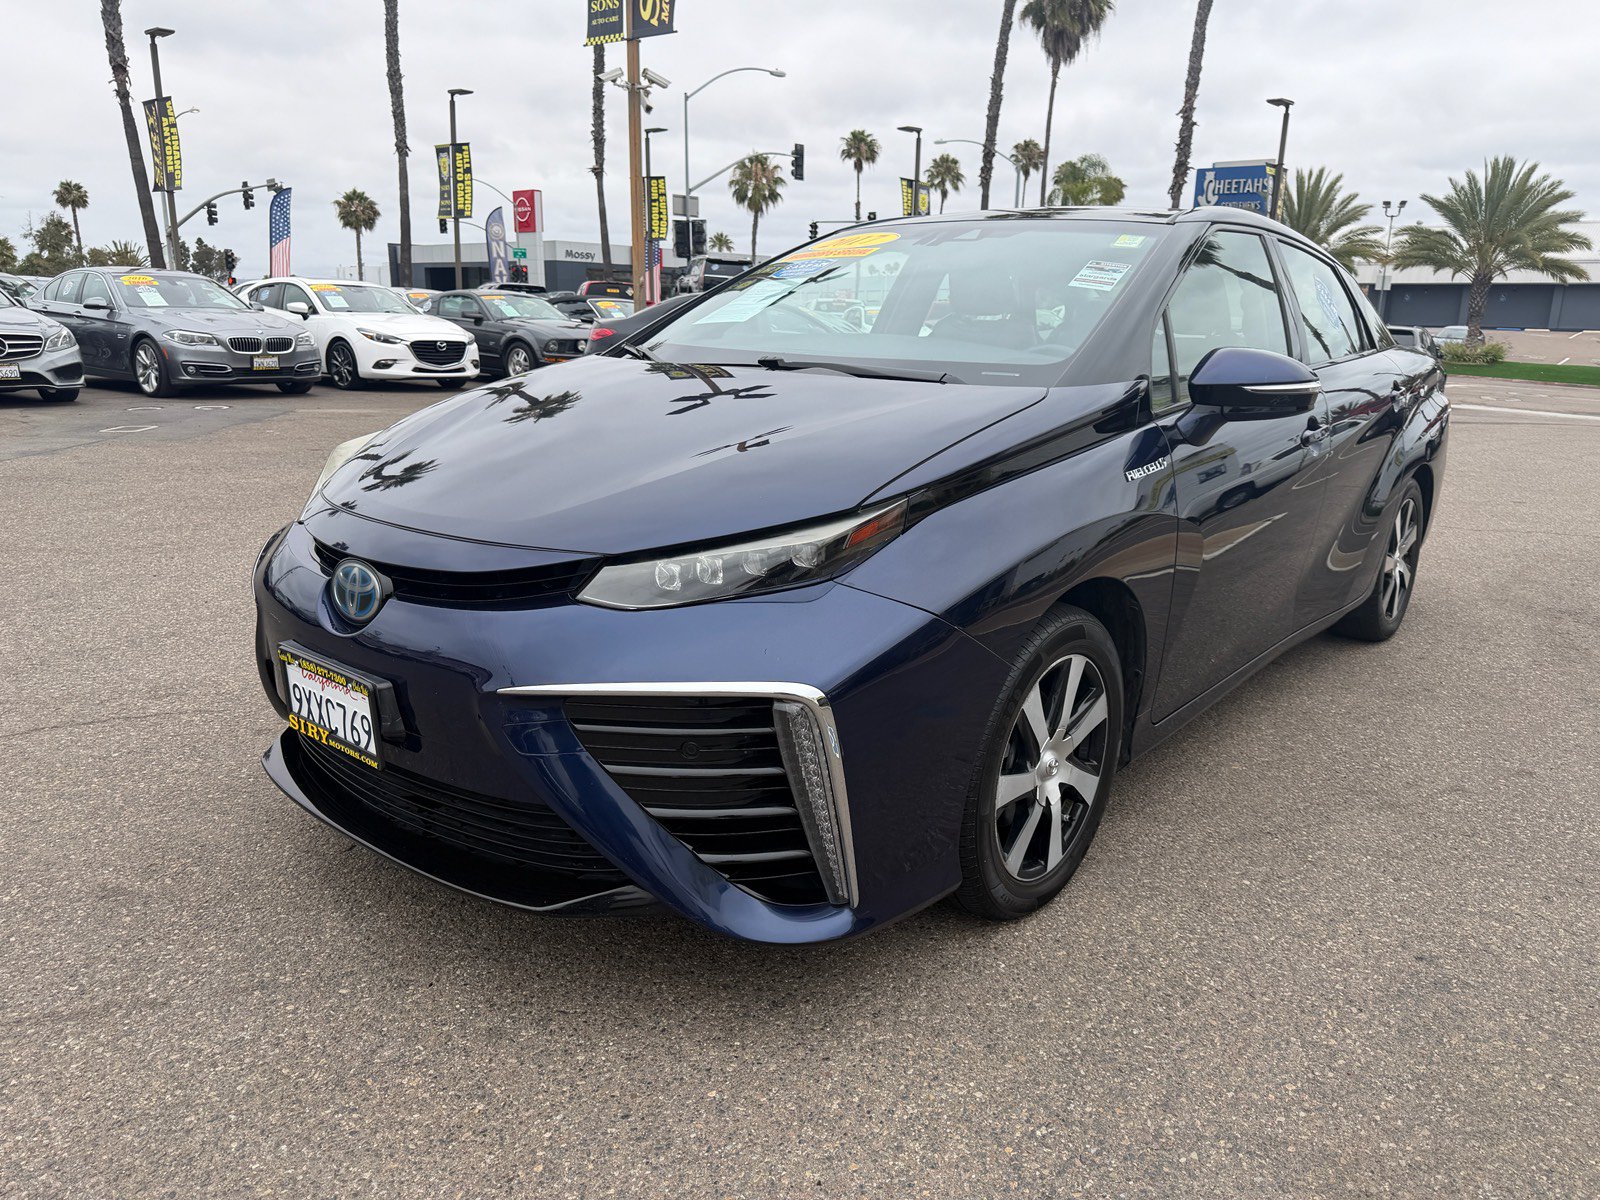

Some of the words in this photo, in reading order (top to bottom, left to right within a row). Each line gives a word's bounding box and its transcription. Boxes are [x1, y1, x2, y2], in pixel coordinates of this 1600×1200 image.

[591, 0, 619, 13] SONS
[162, 117, 174, 173] ANYONE
[166, 101, 175, 124] WE
[171, 128, 181, 187] FINANCE
[461, 145, 471, 169] FULL
[455, 152, 464, 181] AUTO
[456, 182, 465, 210] CARE
[464, 173, 472, 216] SERVICE
[650, 179, 659, 200] OUR
[658, 179, 666, 195] WE
[1205, 177, 1269, 204] CHEETAHS
[651, 201, 660, 239] TROOPS
[659, 195, 668, 239] SUPPORT
[565, 249, 596, 262] Mossy
[301, 668, 358, 701] California
[317, 666, 346, 686] 277-7300
[292, 683, 372, 750] 9XXC769
[288, 713, 330, 745] SIRY
[329, 740, 379, 769] MOTORS.COM
